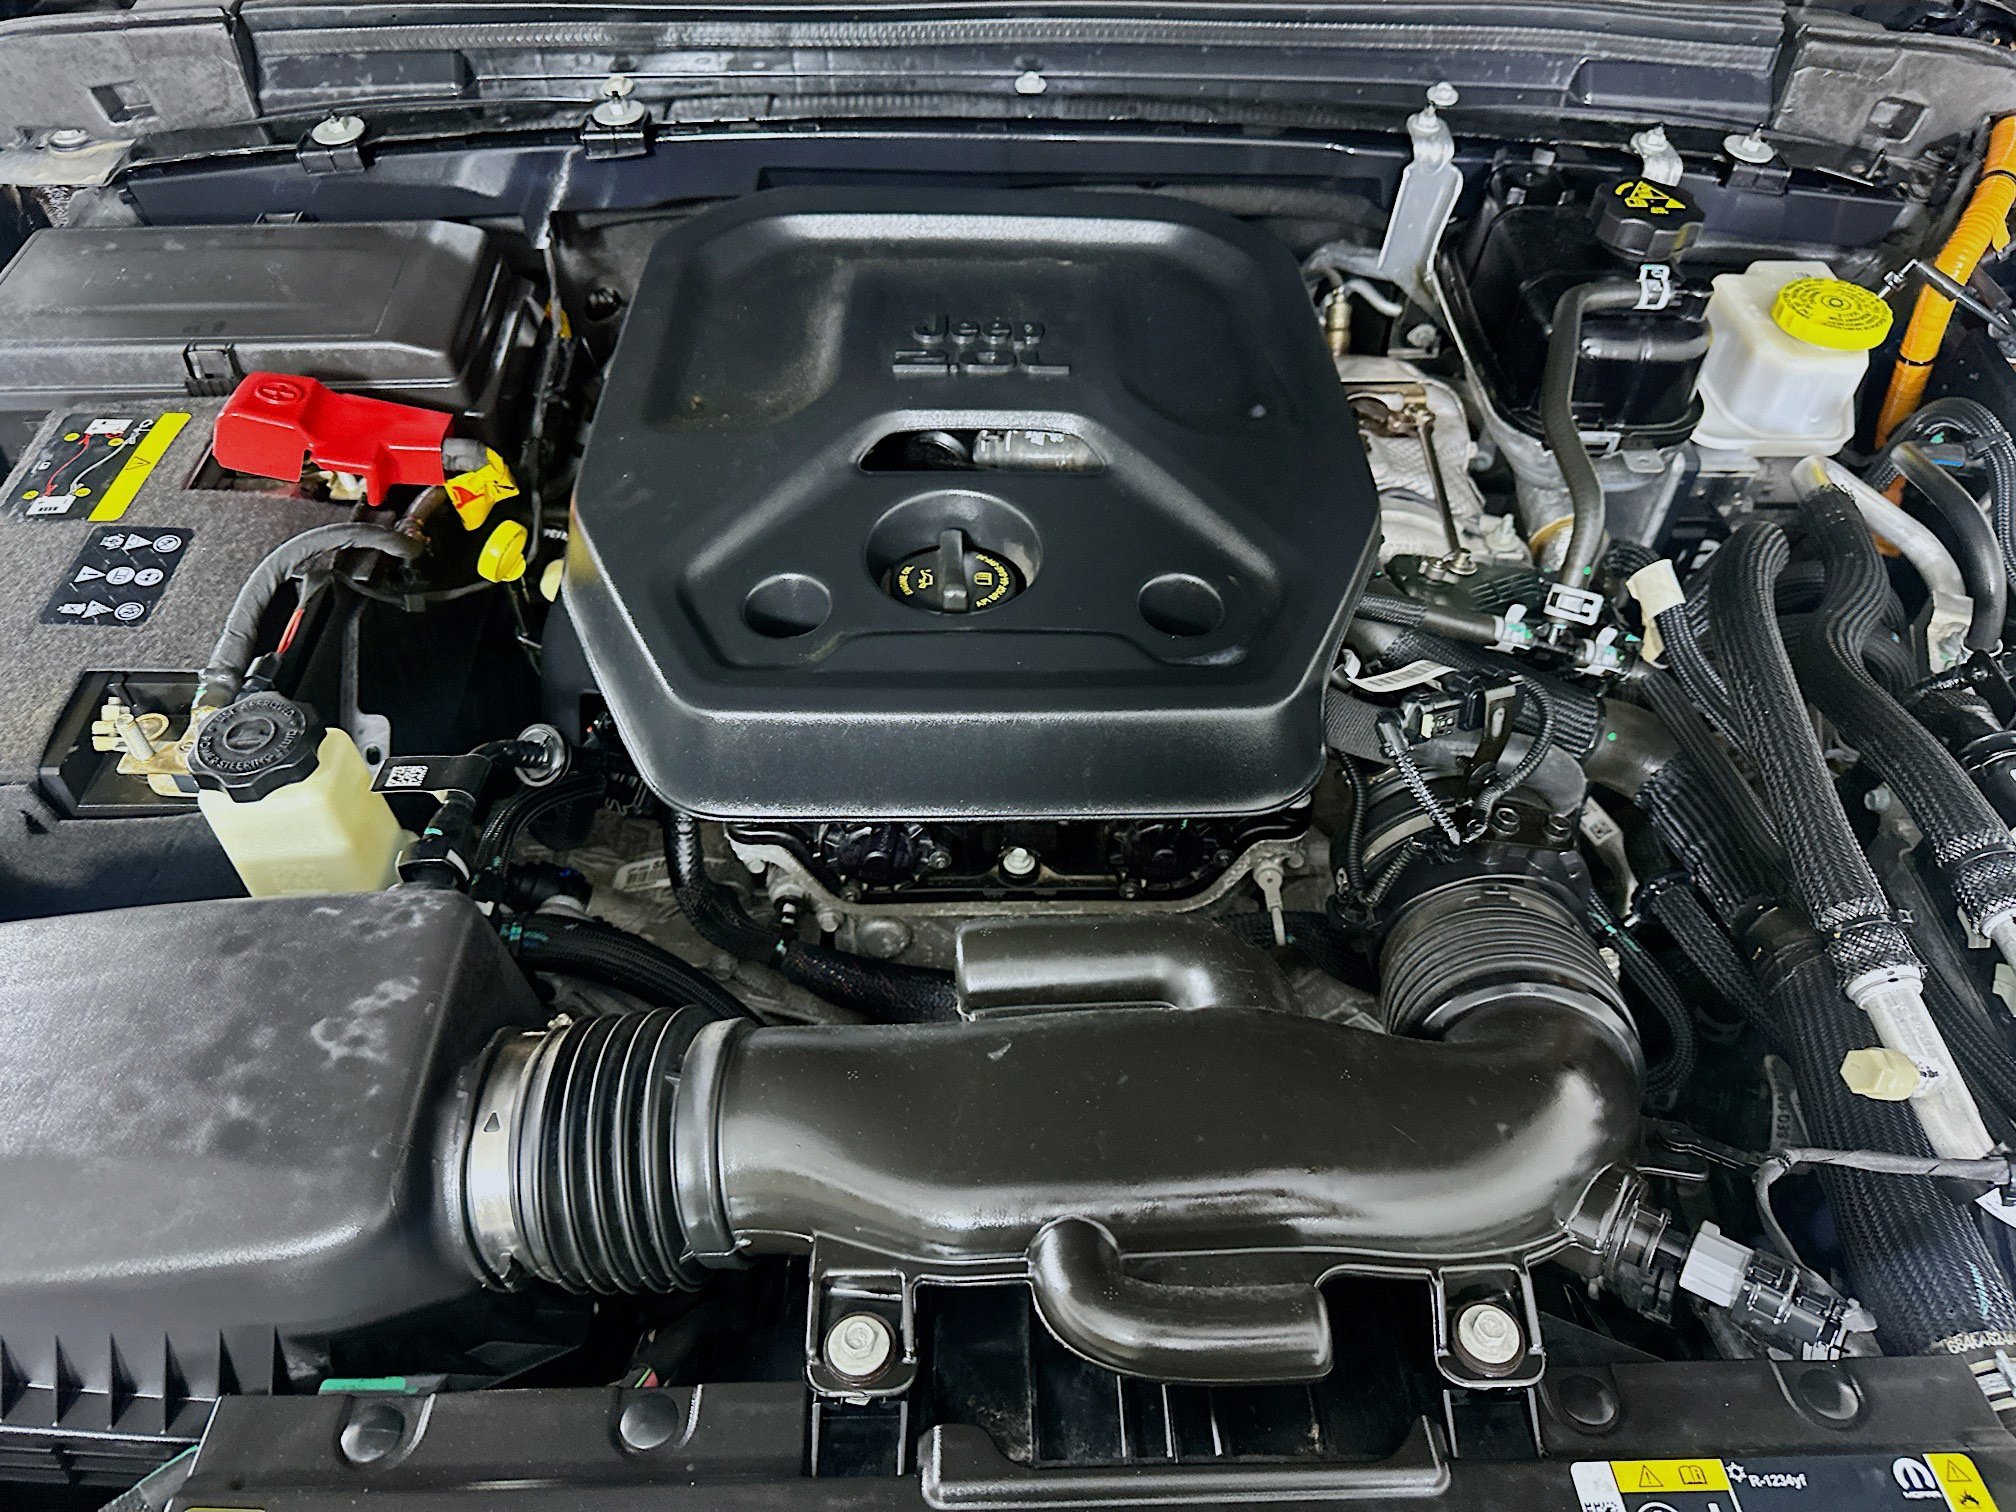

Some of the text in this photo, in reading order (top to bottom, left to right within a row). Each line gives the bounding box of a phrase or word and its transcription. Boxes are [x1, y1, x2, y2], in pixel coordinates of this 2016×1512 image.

[912, 314, 1046, 349] Jeep
[898, 574, 914, 596] ENGINE
[1748, 1473, 1808, 1490] R-1234yf
